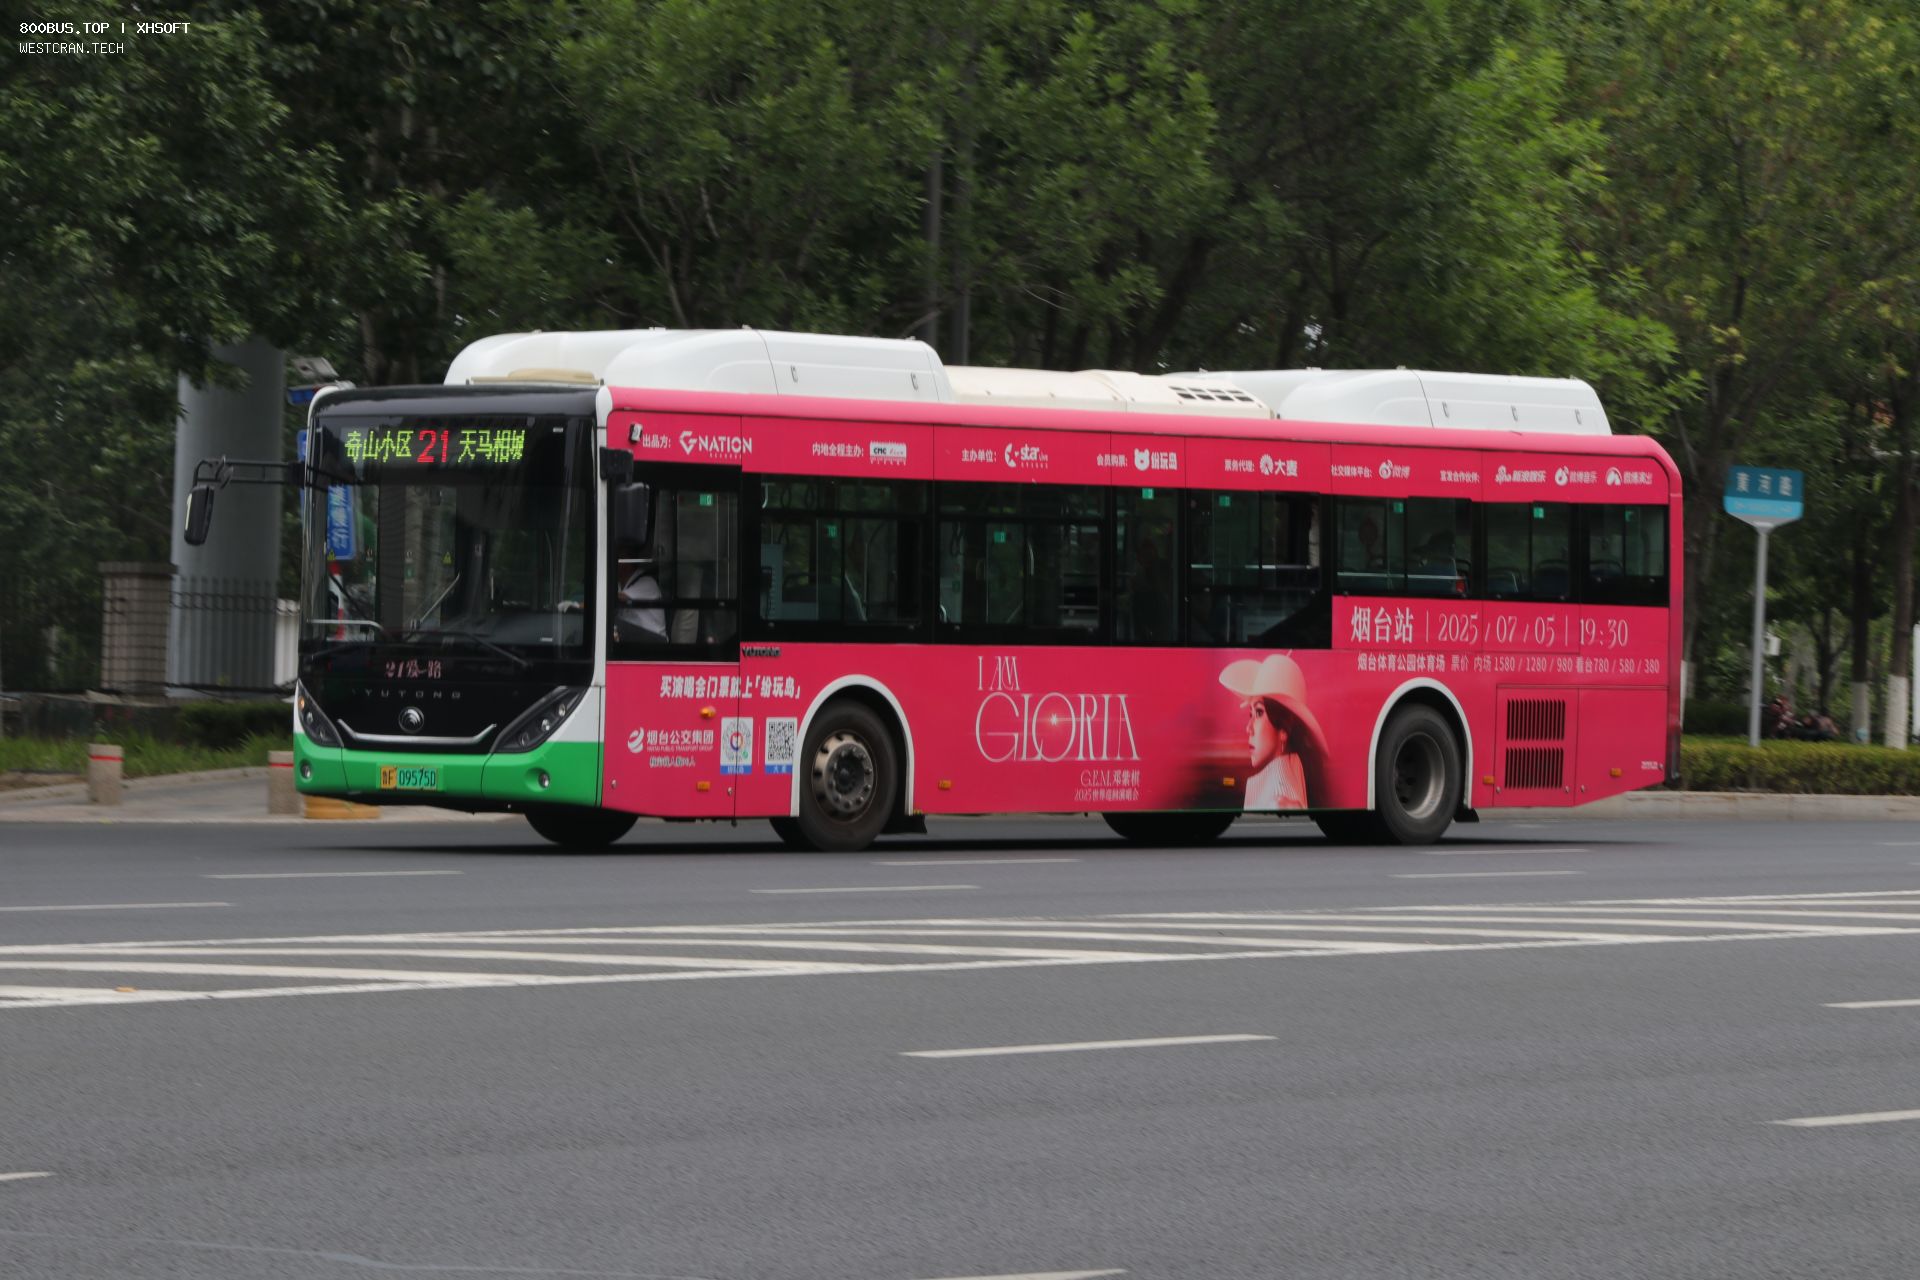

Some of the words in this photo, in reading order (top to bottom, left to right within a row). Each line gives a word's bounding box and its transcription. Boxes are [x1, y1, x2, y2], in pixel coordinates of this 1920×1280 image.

[345, 430, 414, 463] 奇山小区
[417, 430, 449, 463] 21
[1350, 605, 1414, 643] 烟台站
[1580, 617, 1629, 650] 19:30
[365, 689, 461, 699] YUTONG
[647, 729, 714, 745] 烟台公交集团
[975, 691, 1142, 763] GLORIA
